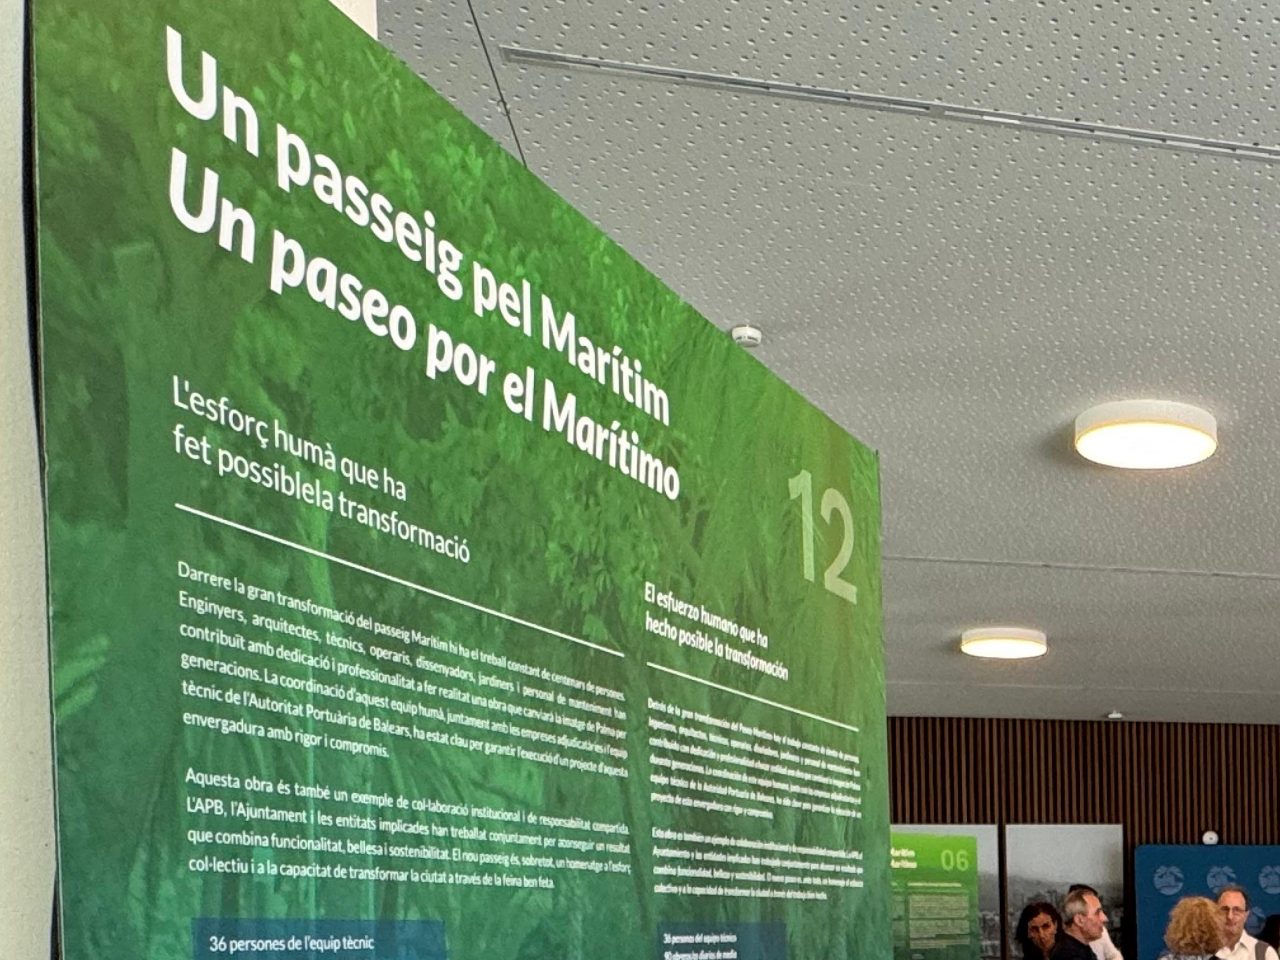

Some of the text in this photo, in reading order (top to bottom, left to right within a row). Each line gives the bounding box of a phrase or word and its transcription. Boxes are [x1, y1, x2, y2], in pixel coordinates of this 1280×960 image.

[167, 26, 669, 426] Un passeig pel Marítim
[170, 148, 680, 500] Un paseo por el Marítimo
[173, 376, 406, 501] L'esforç humà que ha
[174, 424, 470, 563] fet possiblela transformació
[788, 469, 857, 605] 12
[178, 561, 231, 590] Darrere
[234, 577, 245, 594] la
[247, 585, 275, 603] gran
[277, 591, 355, 625] transformació
[356, 614, 373, 630] del
[374, 622, 410, 644] passeig
[645, 582, 768, 648] El esfuerzo humano que ha
[179, 590, 247, 624] Enginyers,
[252, 614, 321, 643] arquitectes,
[326, 632, 366, 655] tècnics,
[369, 646, 413, 666] operaris,
[416, 656, 476, 683] dissenyadors,
[248, 640, 275, 657] amb
[276, 645, 331, 670] dedicació
[331, 657, 336, 671] i
[337, 662, 416, 691] professionalitat
[417, 682, 423, 692] a
[423, 680, 437, 695] fer
[645, 611, 788, 680] hecho posible la transformación
[181, 653, 262, 682] generacions.
[264, 668, 278, 685] La
[279, 675, 346, 699] coordinació
[346, 687, 389, 709] d'aquest
[390, 700, 418, 716] equip
[182, 680, 223, 701] tècnic
[225, 688, 241, 705] de
[243, 691, 304, 717] l'Autoritat
[306, 703, 357, 727] Portuària
[358, 715, 372, 730] de
[373, 717, 412, 739] Balears,
[413, 725, 425, 740] ha
[426, 731, 449, 745] estat
[183, 712, 265, 737] envergadura
[267, 726, 293, 742] amb
[295, 730, 323, 748] rigor
[324, 733, 328, 747] i
[185, 767, 240, 789] Aquesta
[244, 776, 273, 793] obra
[277, 780, 291, 795] és
[294, 783, 330, 800] també
[334, 790, 348, 802] un
[351, 792, 394, 808] exemple
[396, 795, 409, 809] de
[187, 796, 227, 817] L'APB,
[231, 801, 307, 823] l'Ajuntament
[310, 810, 314, 824] i
[317, 810, 333, 826] les
[335, 814, 376, 830] entitats
[379, 817, 430, 835] implicades
[431, 823, 449, 837] han
[187, 830, 213, 845] que
[215, 830, 269, 847] combina
[271, 833, 346, 854] funcionalitat,
[347, 839, 383, 855] bellesa
[384, 842, 388, 855] i
[189, 856, 248, 874] col·lectiu
[251, 859, 255, 874] i
[257, 863, 265, 874] a
[267, 860, 278, 875] la
[279, 862, 332, 878] capacitat
[333, 864, 348, 879] de
[349, 866, 409, 881] transformar
[410, 869, 419, 882] la
[420, 869, 447, 883] ciutat
[941, 849, 968, 871] 06
[209, 935, 374, 954] 36 persones de l'equip tècnic
